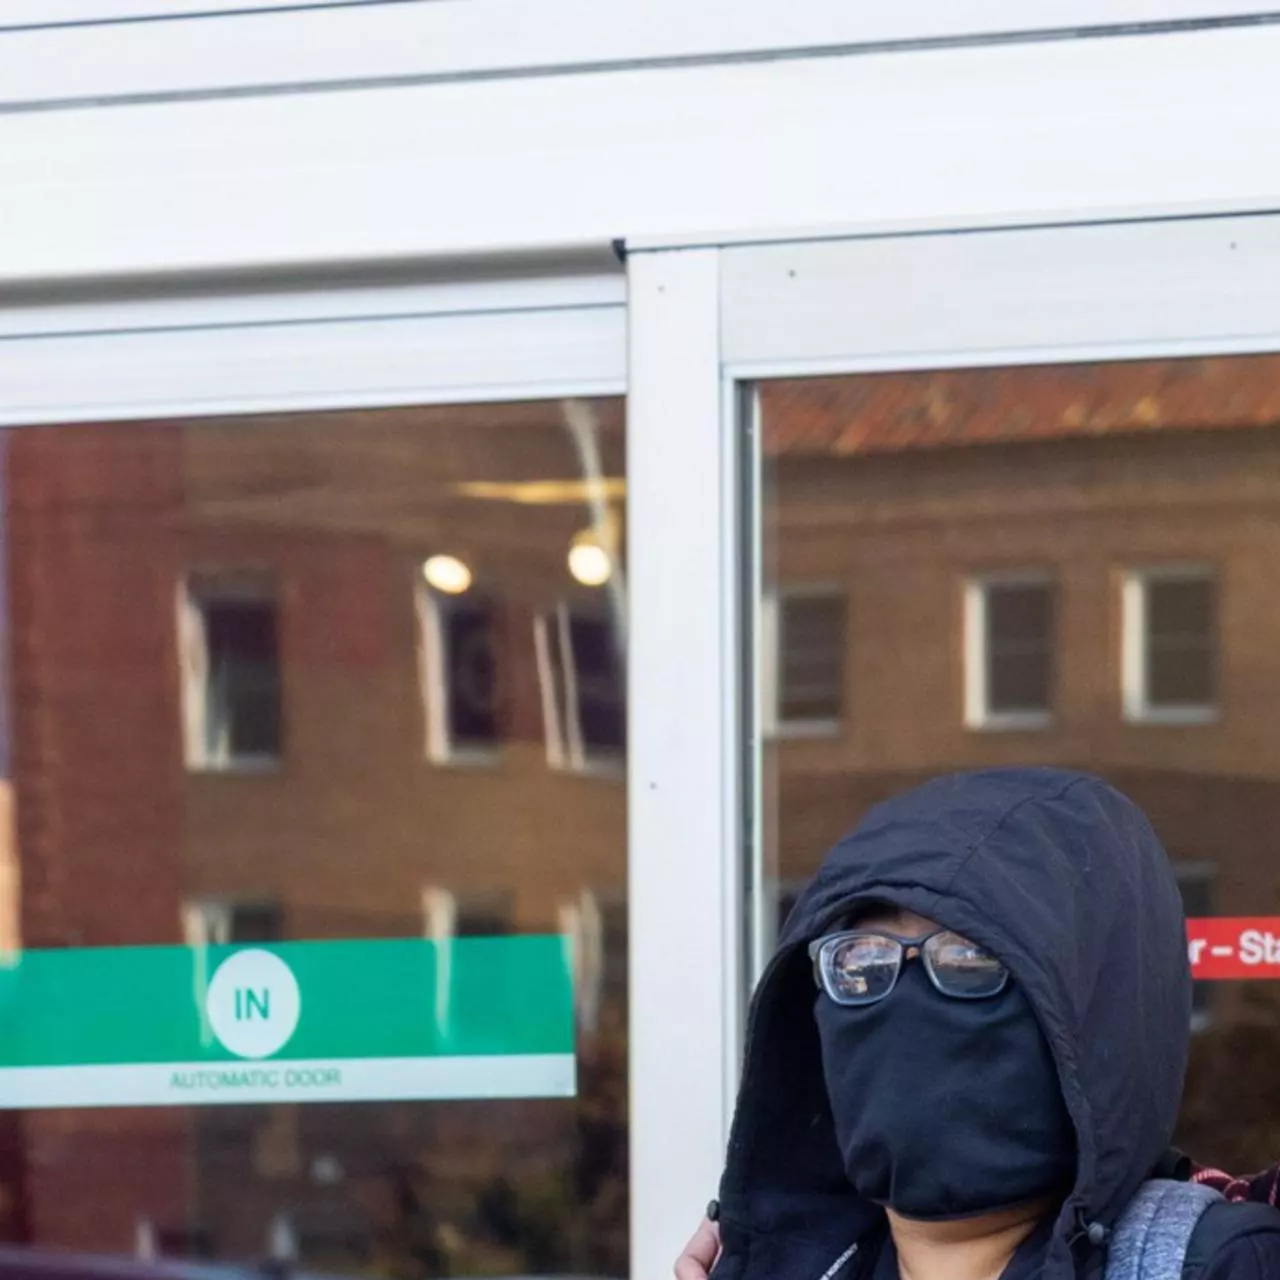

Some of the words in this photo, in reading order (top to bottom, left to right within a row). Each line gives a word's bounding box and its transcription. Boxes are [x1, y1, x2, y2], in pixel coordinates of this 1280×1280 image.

[234, 988, 270, 1020] IN
[169, 1069, 280, 1091] AUTOMATIC
[284, 1069, 342, 1088] DOOR
